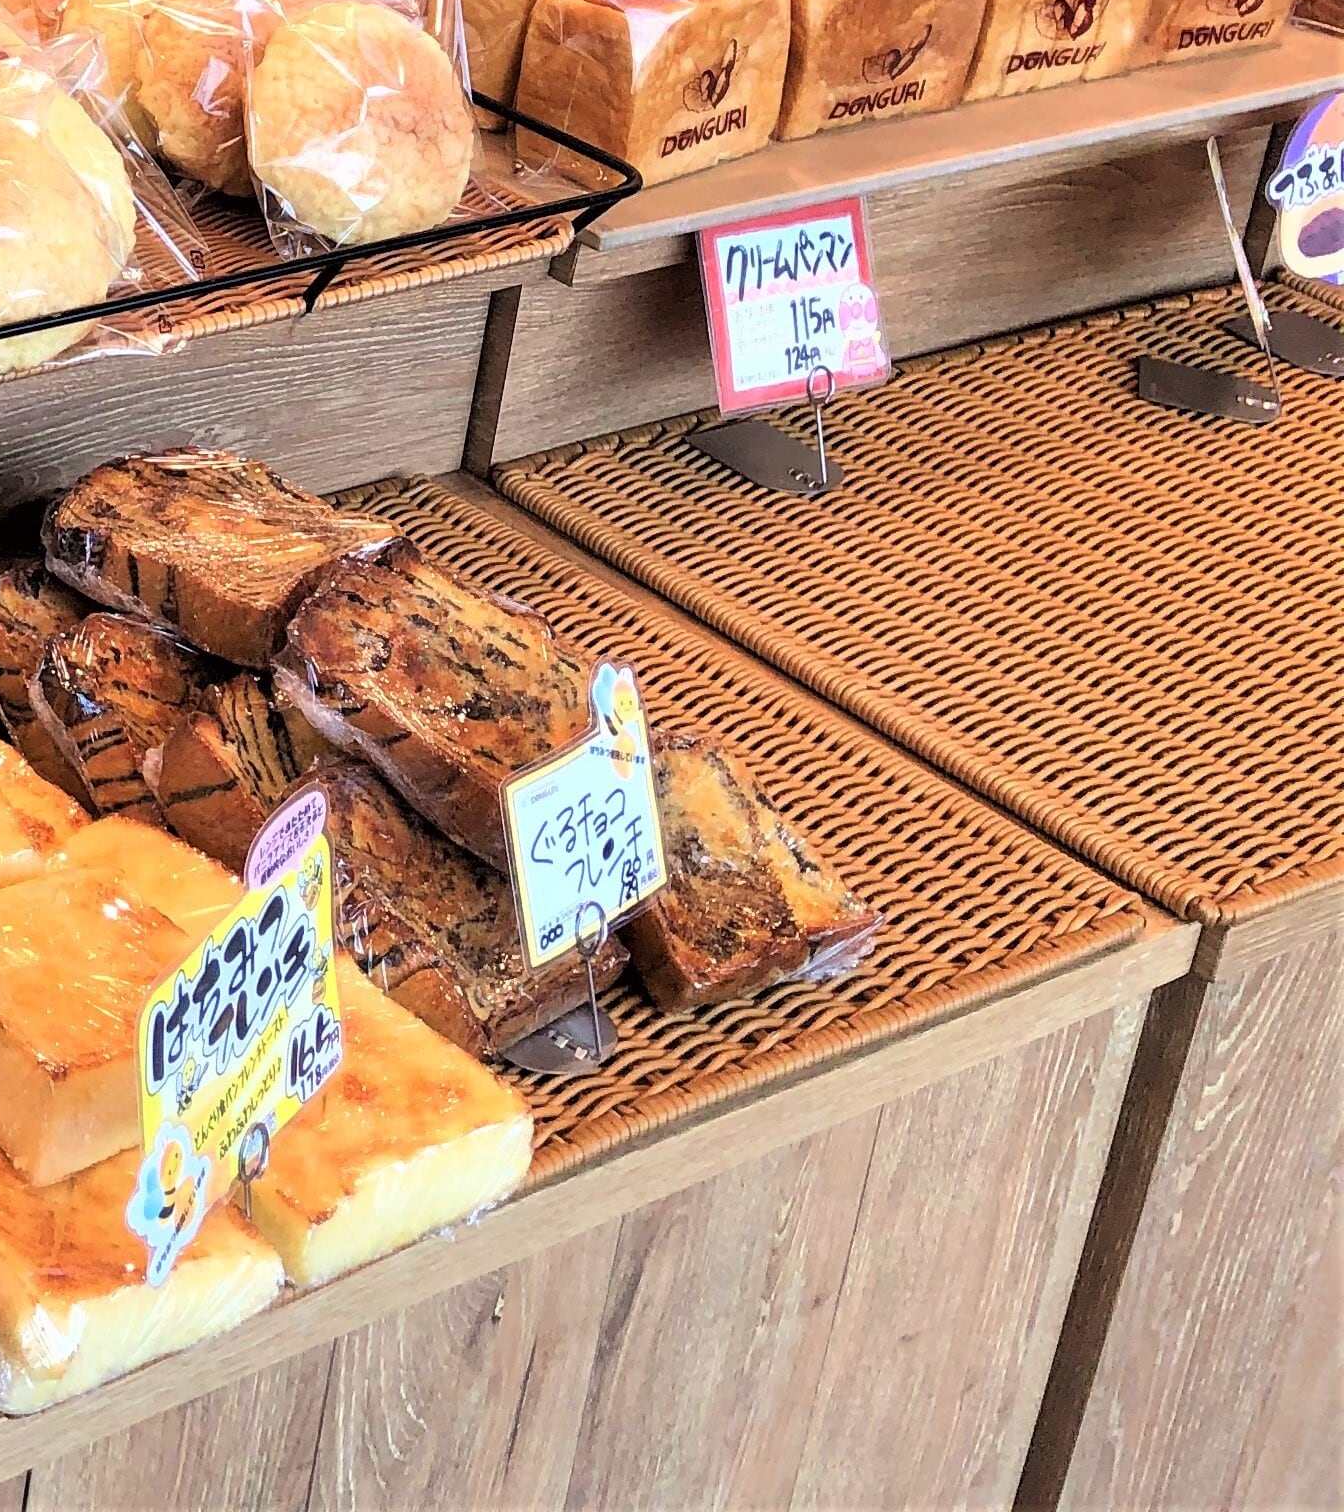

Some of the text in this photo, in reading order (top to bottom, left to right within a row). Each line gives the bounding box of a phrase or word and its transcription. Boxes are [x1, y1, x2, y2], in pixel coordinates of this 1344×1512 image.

[1005, 41, 1108, 76] DONGURI
[1177, 18, 1274, 51] DONGURI
[827, 78, 927, 122] DONGURI
[661, 104, 748, 160] DONGURI
[1274, 152, 1344, 206] つぶあ
[564, 813, 643, 894] フレンチ
[151, 893, 285, 1085] はちみつ
[209, 938, 311, 1065] フレンチ
